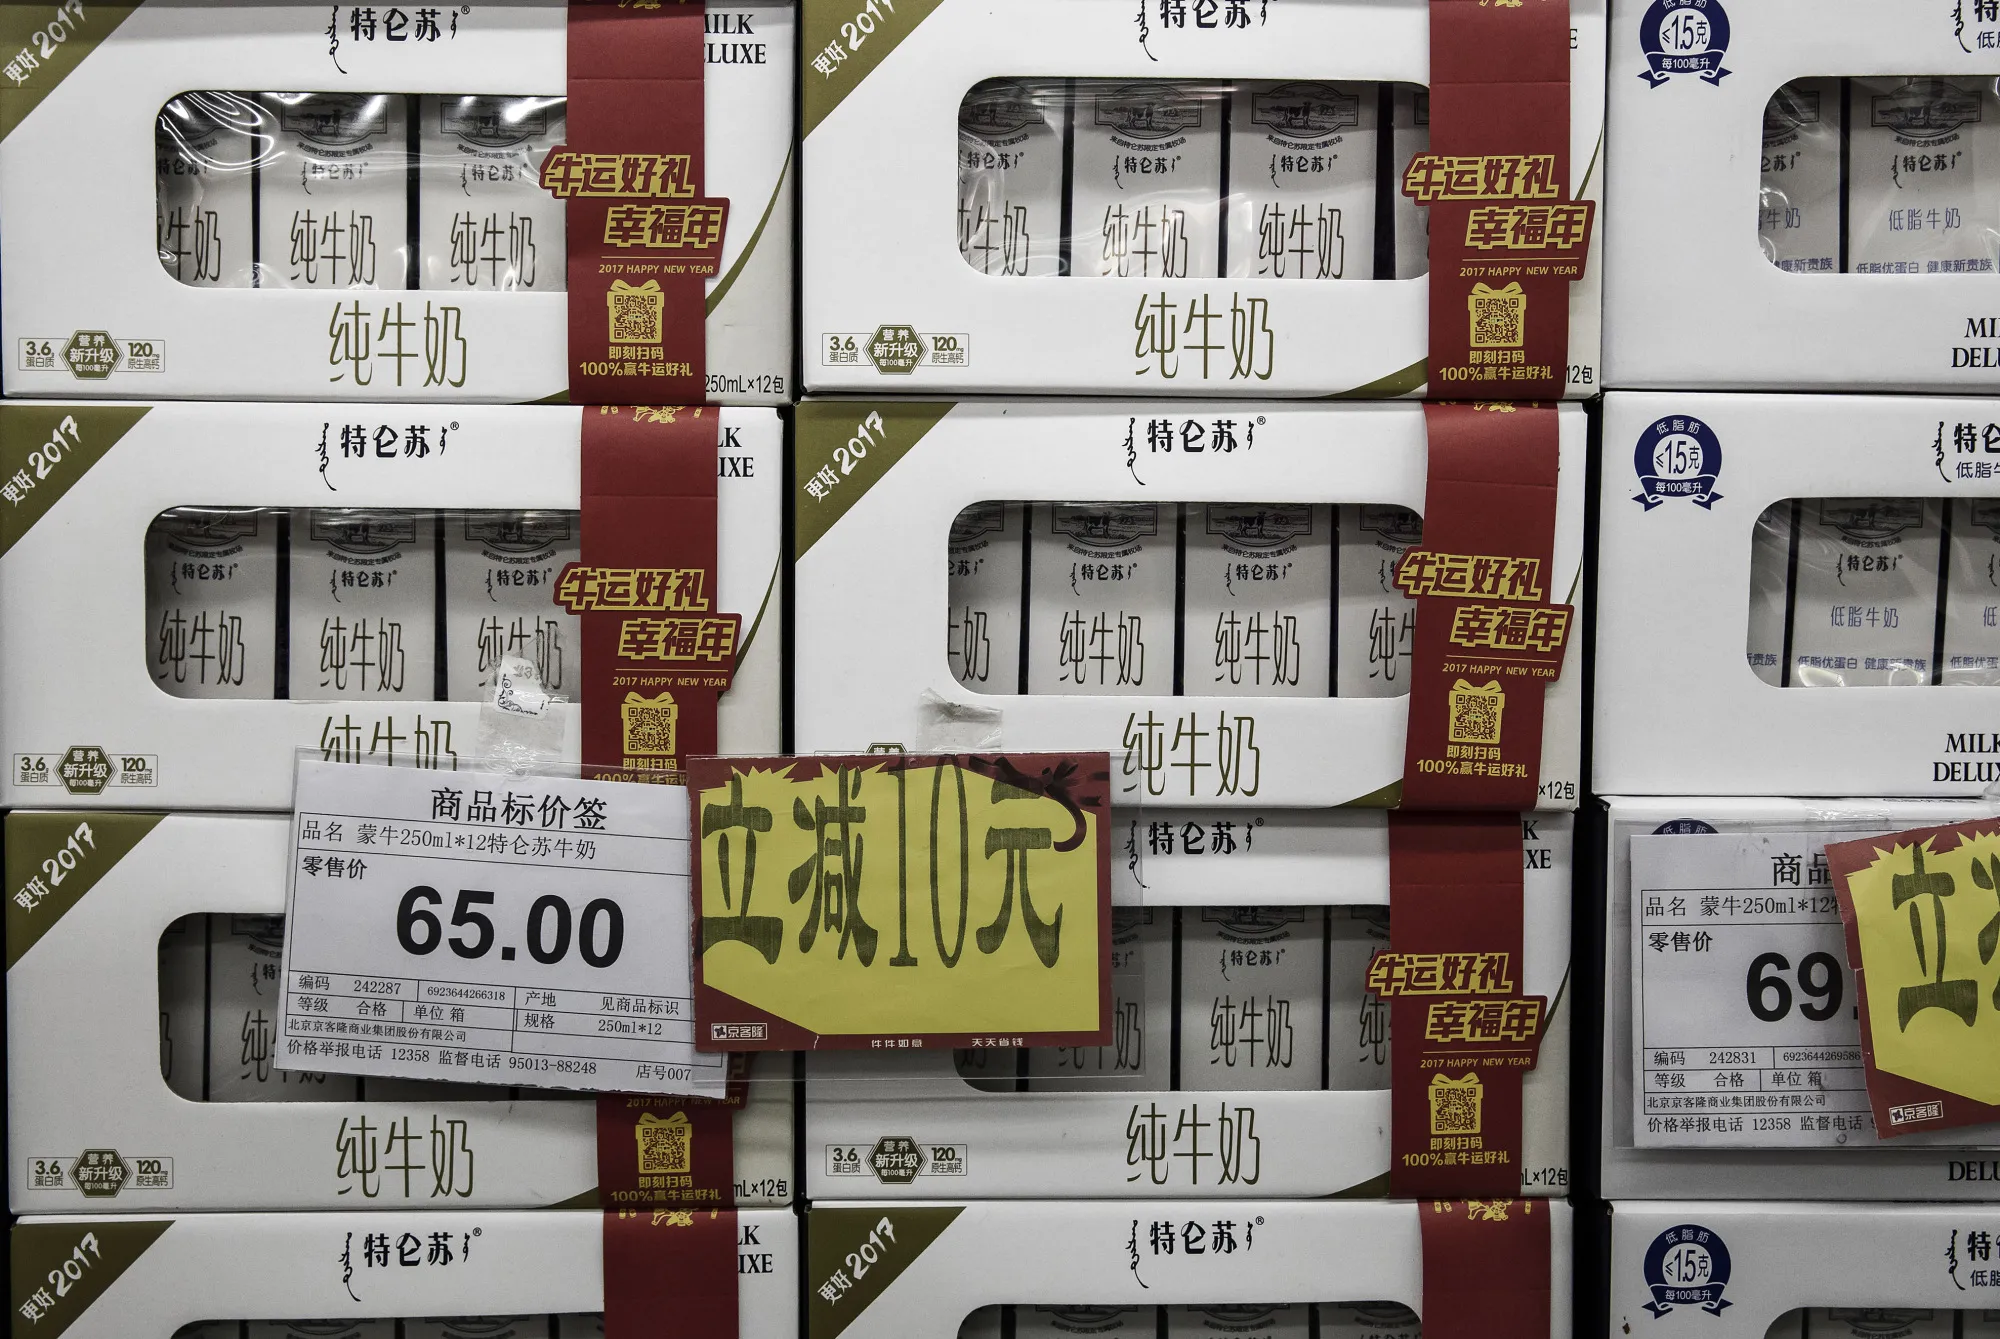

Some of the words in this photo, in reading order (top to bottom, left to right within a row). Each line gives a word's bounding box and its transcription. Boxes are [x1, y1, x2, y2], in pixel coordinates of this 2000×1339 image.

[350, 8, 441, 42] 特仑苏
[704, 44, 766, 64] LUXE
[811, 40, 848, 79] 更好
[1662, 57, 1710, 70] 每100毫升
[2, 48, 40, 87] 更好
[544, 153, 695, 198] 牛运好礼
[1406, 155, 1559, 200] 牛运好礼
[604, 205, 723, 248] 幸福年
[1465, 206, 1588, 249] 幸福年
[1888, 208, 1961, 231] 低脂牛奶
[291, 209, 376, 285] 纯牛奶
[450, 212, 535, 287] 纯牛奶
[1102, 204, 1188, 278] 纯牛奶
[1259, 203, 1345, 279] 纯牛奶
[599, 265, 623, 274] 2017
[626, 265, 659, 274] HAPPY
[664, 265, 685, 273] NEW
[690, 265, 713, 273] YEAR
[1460, 266, 1485, 277] 2017
[1488, 266, 1521, 276] HAPPY
[1527, 266, 1548, 275] NEW
[1552, 266, 1578, 275] YEAR
[1927, 259, 1992, 272] 健康新贵族
[78, 335, 105, 347] 营养
[329, 300, 467, 388] 纯牛奶
[882, 329, 909, 341] 营养
[1134, 292, 1274, 380] 纯牛奶
[69, 348, 113, 363] 新升级
[608, 346, 664, 360] 即刻扫码
[829, 352, 858, 363] 蛋白质
[873, 342, 918, 358] 新升级
[1469, 350, 1525, 364] 即刻扫码
[26, 357, 55, 368] 蛋白质
[580, 362, 693, 377] 100%赢牛运好礼
[1439, 366, 1553, 381] 100%赢牛运好礼
[1148, 419, 1238, 452] 特仑苏
[1656, 419, 1700, 435] 低脂肪
[341, 424, 430, 458] 特仑苏
[1, 470, 35, 506] 更好
[28, 415, 82, 479] 2017
[804, 466, 840, 503] 更好
[833, 411, 888, 476] 2017
[1655, 482, 1702, 493] 每100毫升
[1398, 552, 1546, 601] 牛运好礼
[560, 568, 709, 611] 牛运好礼
[1450, 605, 1571, 652] 幸福年
[1831, 606, 1899, 628] 低脂牛奶
[159, 609, 245, 686] 纯牛奶
[618, 618, 737, 661] 幸福年
[1059, 610, 1144, 686] 纯牛奶
[1215, 610, 1300, 686] 纯牛奶
[320, 616, 404, 693] 纯牛奶
[1442, 663, 1467, 672] 2017
[1470, 664, 1502, 674] HAPPY
[1506, 666, 1528, 675] NEW
[1532, 667, 1555, 677] YEAR
[613, 677, 637, 686] 2017
[640, 678, 673, 687] HAPPY
[678, 678, 699, 686] NEW
[703, 678, 727, 687] YEAR
[72, 751, 99, 762] 营养
[1122, 710, 1260, 796] 纯牛奶
[1447, 745, 1500, 760] 即刻扫码
[21, 772, 48, 783] 蛋白质
[63, 763, 107, 778] 新升级
[1417, 760, 1528, 778] 100%赢牛运好礼
[431, 787, 608, 831] 商品标价签
[302, 820, 343, 840] 品名
[1149, 821, 1236, 855] 特仑苏
[13, 876, 49, 913] 更好
[43, 822, 98, 887] 2017
[302, 856, 367, 879] 零售价
[698, 753, 1063, 969] 立减10元
[1645, 898, 1687, 916] 品名
[397, 885, 624, 968] 65.00
[1649, 932, 1712, 952] 零售价
[1369, 953, 1513, 995] 牛运好礼
[299, 975, 330, 991] 编码
[354, 978, 402, 994] 242287
[427, 987, 505, 1001] 6923644266318
[525, 992, 556, 1007] 产地
[600, 997, 679, 1015] 见商品标识
[1746, 952, 1859, 1022] 69.
[298, 997, 328, 1012] 等级
[357, 1001, 387, 1016] 合格
[413, 1005, 444, 1020] 单位
[450, 1007, 465, 1022] 箱
[524, 1013, 555, 1029] 规格
[1425, 1000, 1541, 1042] 幸福年
[288, 1018, 467, 1042] 北京京客隆商业集团股份有限公司
[728, 1026, 764, 1038] 京客隆
[1210, 995, 1292, 1068] 纯牛奶
[871, 1039, 923, 1048] 件件如意
[972, 1038, 1023, 1047] 天天省钱
[287, 1040, 382, 1060] 价格举报电话
[391, 1047, 430, 1063] 12358
[438, 1051, 501, 1068] 监督电话
[509, 1058, 597, 1074] 95013-88248
[636, 1065, 691, 1081] 店号007
[1420, 1059, 1444, 1068] 2017
[1447, 1058, 1478, 1068] HAPPY
[1482, 1058, 1504, 1067] NEW
[1508, 1057, 1531, 1066] YEAR
[1654, 1051, 1685, 1066] 编码
[1709, 1052, 1756, 1064] 242831
[1654, 1073, 1685, 1088] 等级
[1714, 1072, 1744, 1088] 合格
[1771, 1071, 1802, 1086] 单位
[1808, 1071, 1822, 1086] 箱
[1647, 1094, 1826, 1108] 北京京客隆商业集团股份有限公司
[1647, 1116, 1743, 1133] 价格举报电话
[1752, 1117, 1791, 1131] 12358
[1800, 1116, 1862, 1131] 监督电话
[884, 1141, 909, 1152] 营养
[1126, 1101, 1260, 1185] 纯牛奶
[1430, 1137, 1483, 1150] 即刻扫码
[88, 1154, 114, 1165] 营养
[336, 1114, 474, 1198] 纯牛奶
[833, 1162, 861, 1173] 蛋白质
[875, 1153, 918, 1168] 新升级
[1402, 1152, 1510, 1166] 100%赢牛运好礼
[35, 1176, 63, 1186] 蛋白质
[78, 1166, 122, 1181] 新升级
[638, 1176, 693, 1188] 即刻扫码
[1150, 1220, 1237, 1255] 特仑苏
[1666, 1229, 1708, 1244] 低脂肪
[364, 1232, 454, 1267] 特仑苏
[818, 1269, 853, 1306] 更好
[846, 1216, 897, 1280] 2017
[19, 1287, 56, 1324] 更好
[48, 1232, 102, 1297] 2017
[1665, 1290, 1712, 1301] 每100毫升
